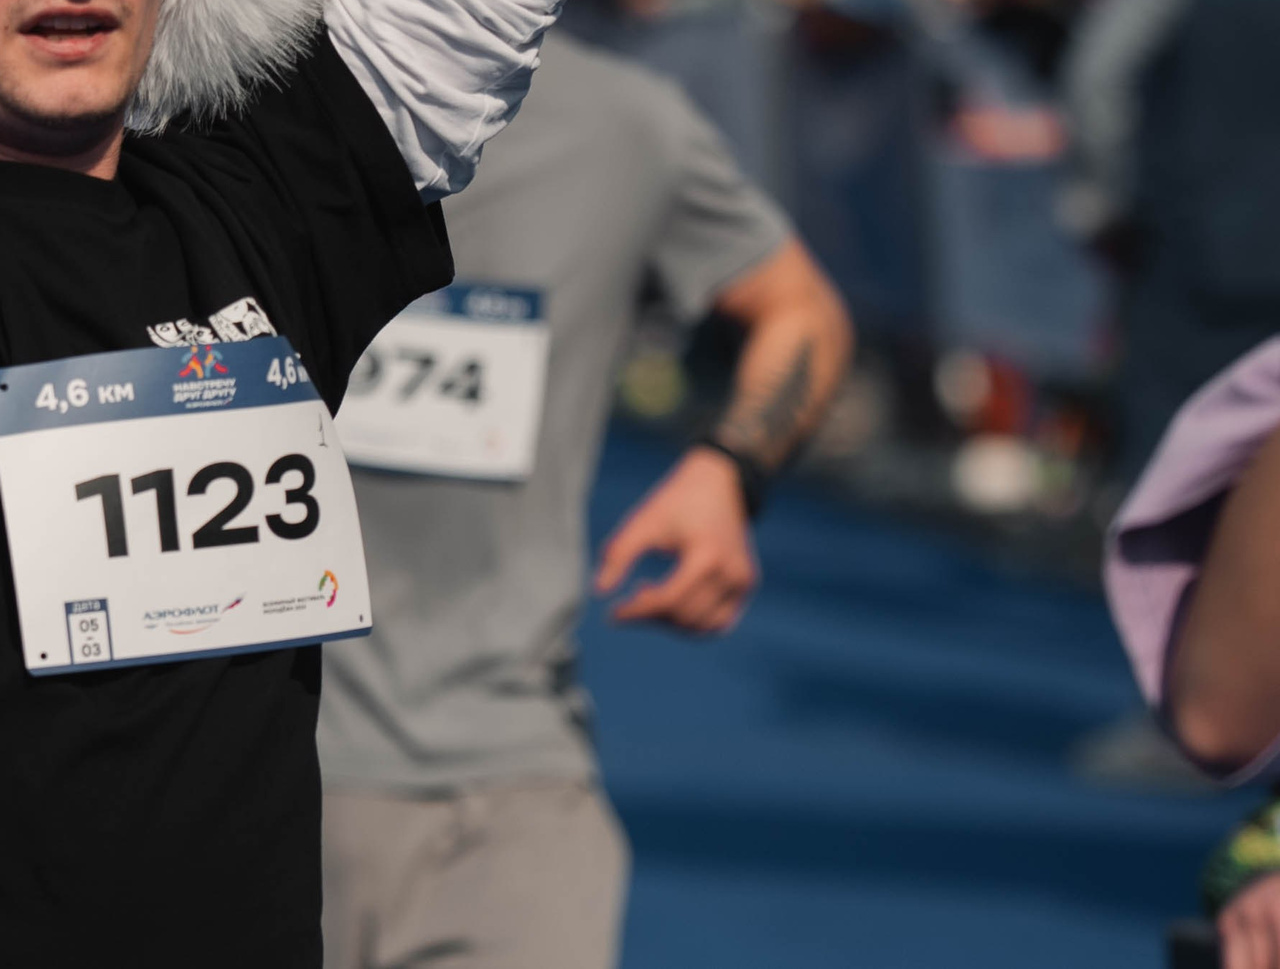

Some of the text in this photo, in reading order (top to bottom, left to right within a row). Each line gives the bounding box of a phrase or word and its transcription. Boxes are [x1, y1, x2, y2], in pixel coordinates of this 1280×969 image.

[266, 356, 297, 390] 4,6
[35, 378, 89, 414] 4,6
[75, 453, 320, 558] 1123
[79, 617, 100, 633] 05
[143, 604, 219, 621] АЭРОФЛОТ
[81, 642, 102, 658] 03
